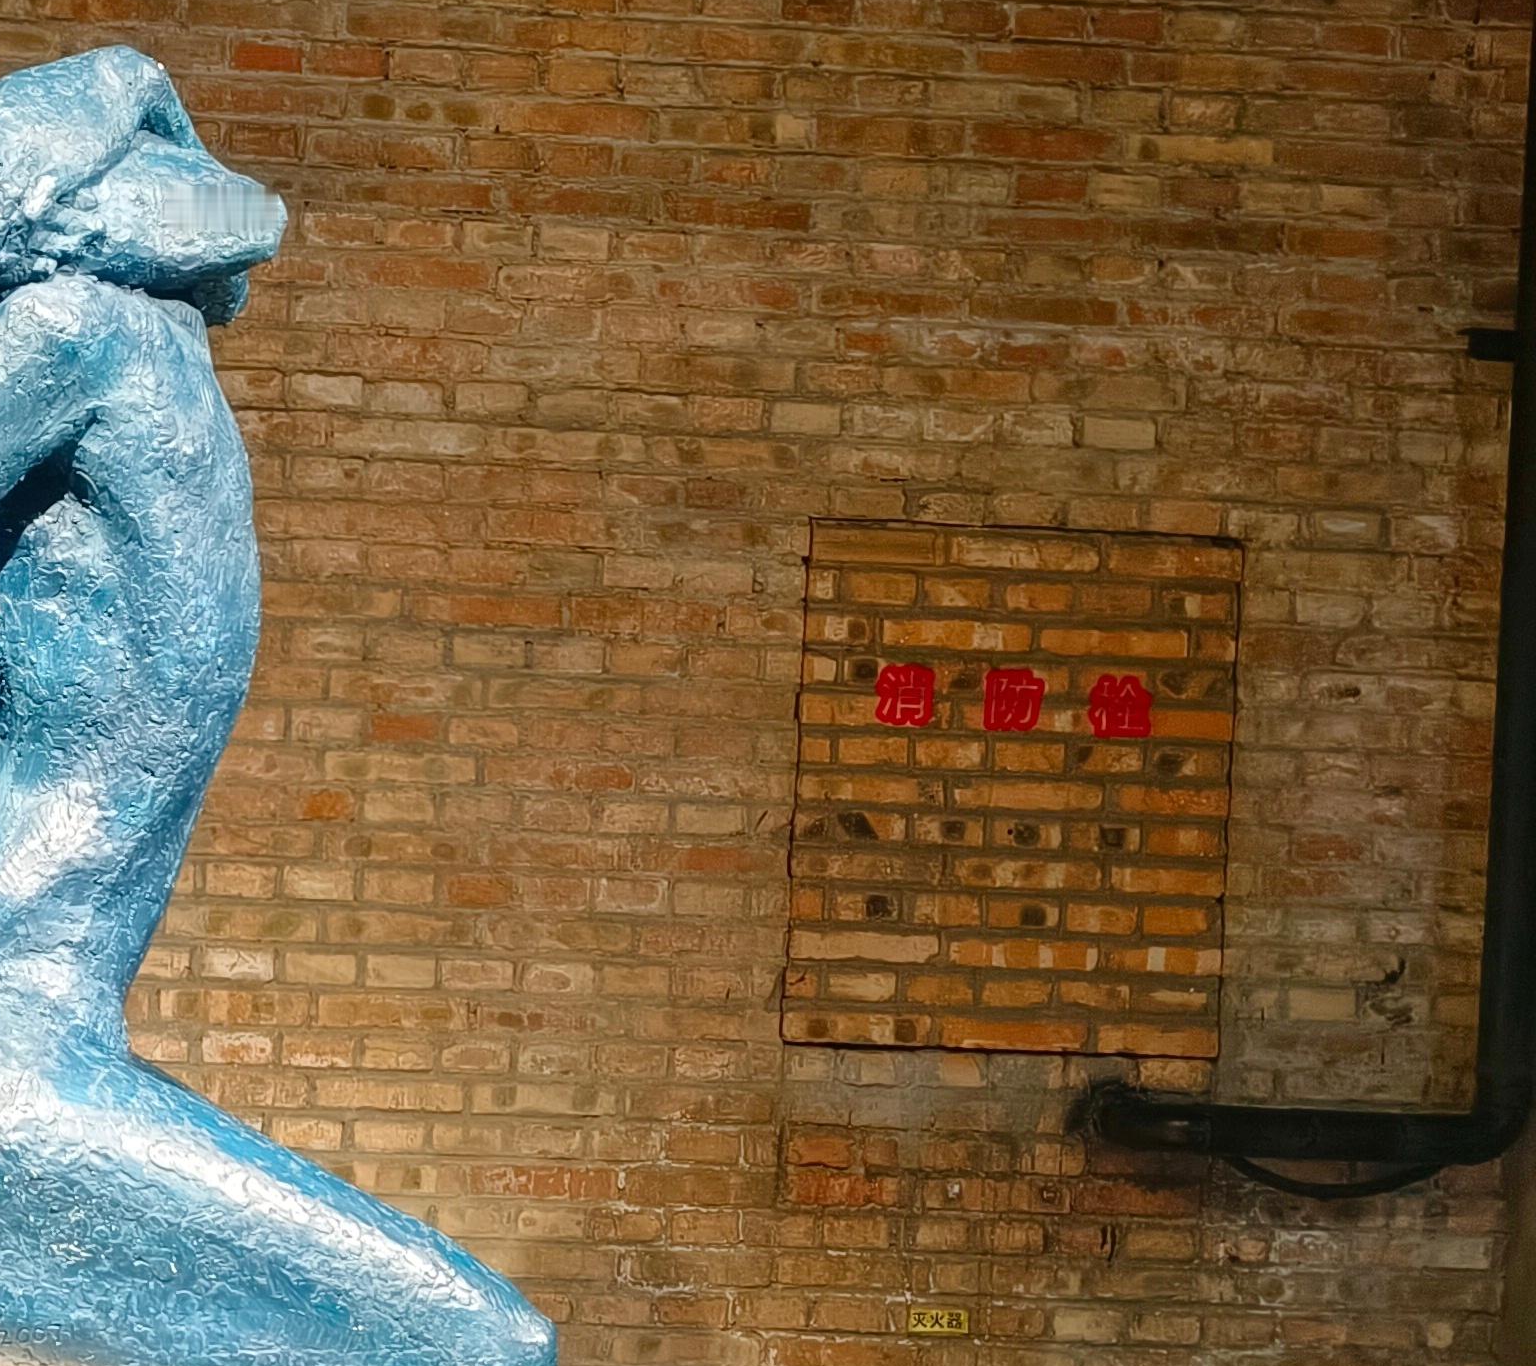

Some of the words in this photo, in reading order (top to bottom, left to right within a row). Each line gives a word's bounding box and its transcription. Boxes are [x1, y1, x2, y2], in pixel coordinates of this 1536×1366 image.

[875, 663, 1153, 738] 消防栓
[912, 1311, 962, 1330] 灭火器
